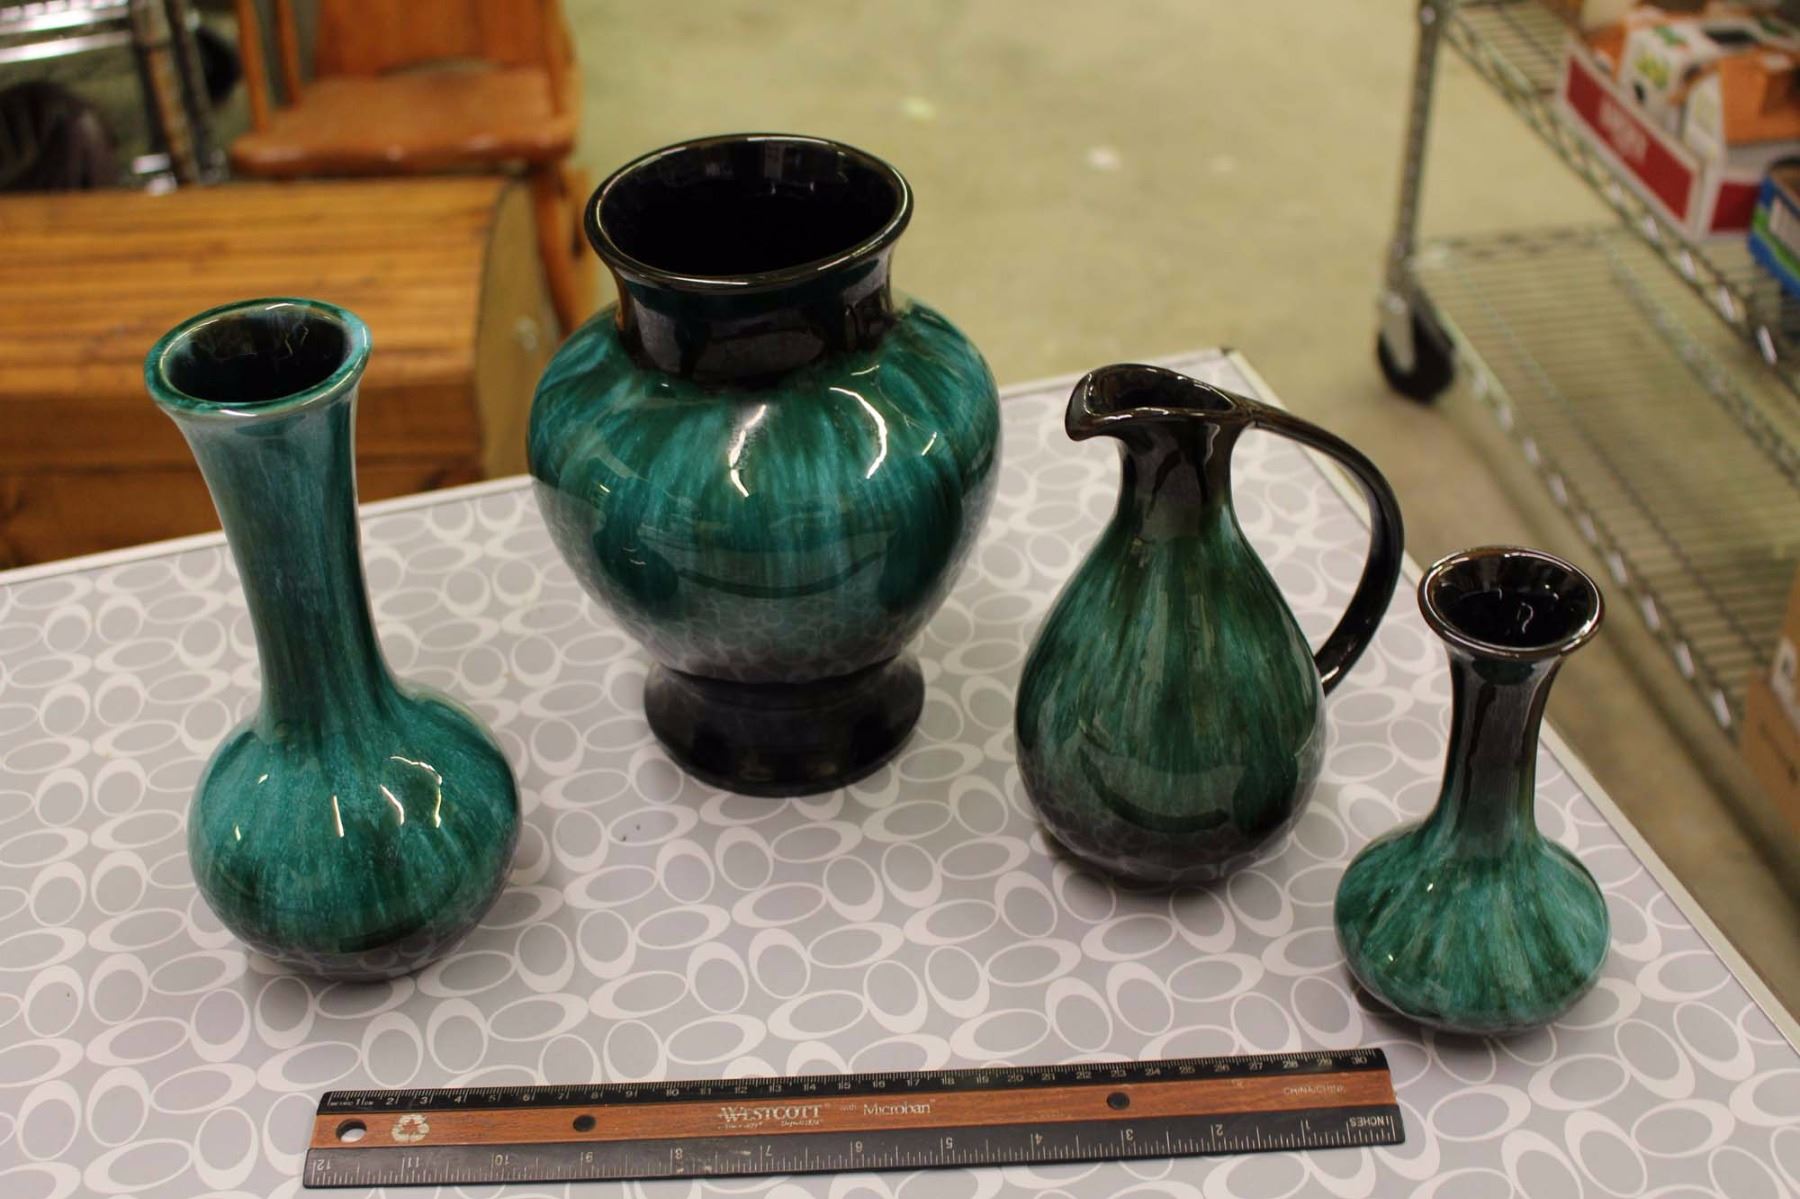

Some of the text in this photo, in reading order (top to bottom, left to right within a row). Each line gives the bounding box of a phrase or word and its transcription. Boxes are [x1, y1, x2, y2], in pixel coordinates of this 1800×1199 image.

[420, 1096, 428, 1104] 3
[454, 1096, 462, 1104] 4
[522, 1094, 529, 1102] 6
[626, 1090, 633, 1098] 9
[735, 1086, 747, 1094] 12
[769, 1085, 782, 1093] 13
[804, 1083, 816, 1091] 14
[907, 1079, 920, 1087] 17
[942, 1077, 955, 1085] 18
[1008, 1074, 1024, 1082] 20
[1042, 1073, 1055, 1081] 21
[1076, 1071, 1091, 1079] 22
[1111, 1069, 1127, 1078] 23
[1145, 1068, 1160, 1076] 24
[1249, 1062, 1263, 1071] 27
[1351, 1056, 1367, 1064] 30
[317, 1116, 1389, 1170] INCHES 1 2 3 4 5 6 7 8 9 10 11 12
